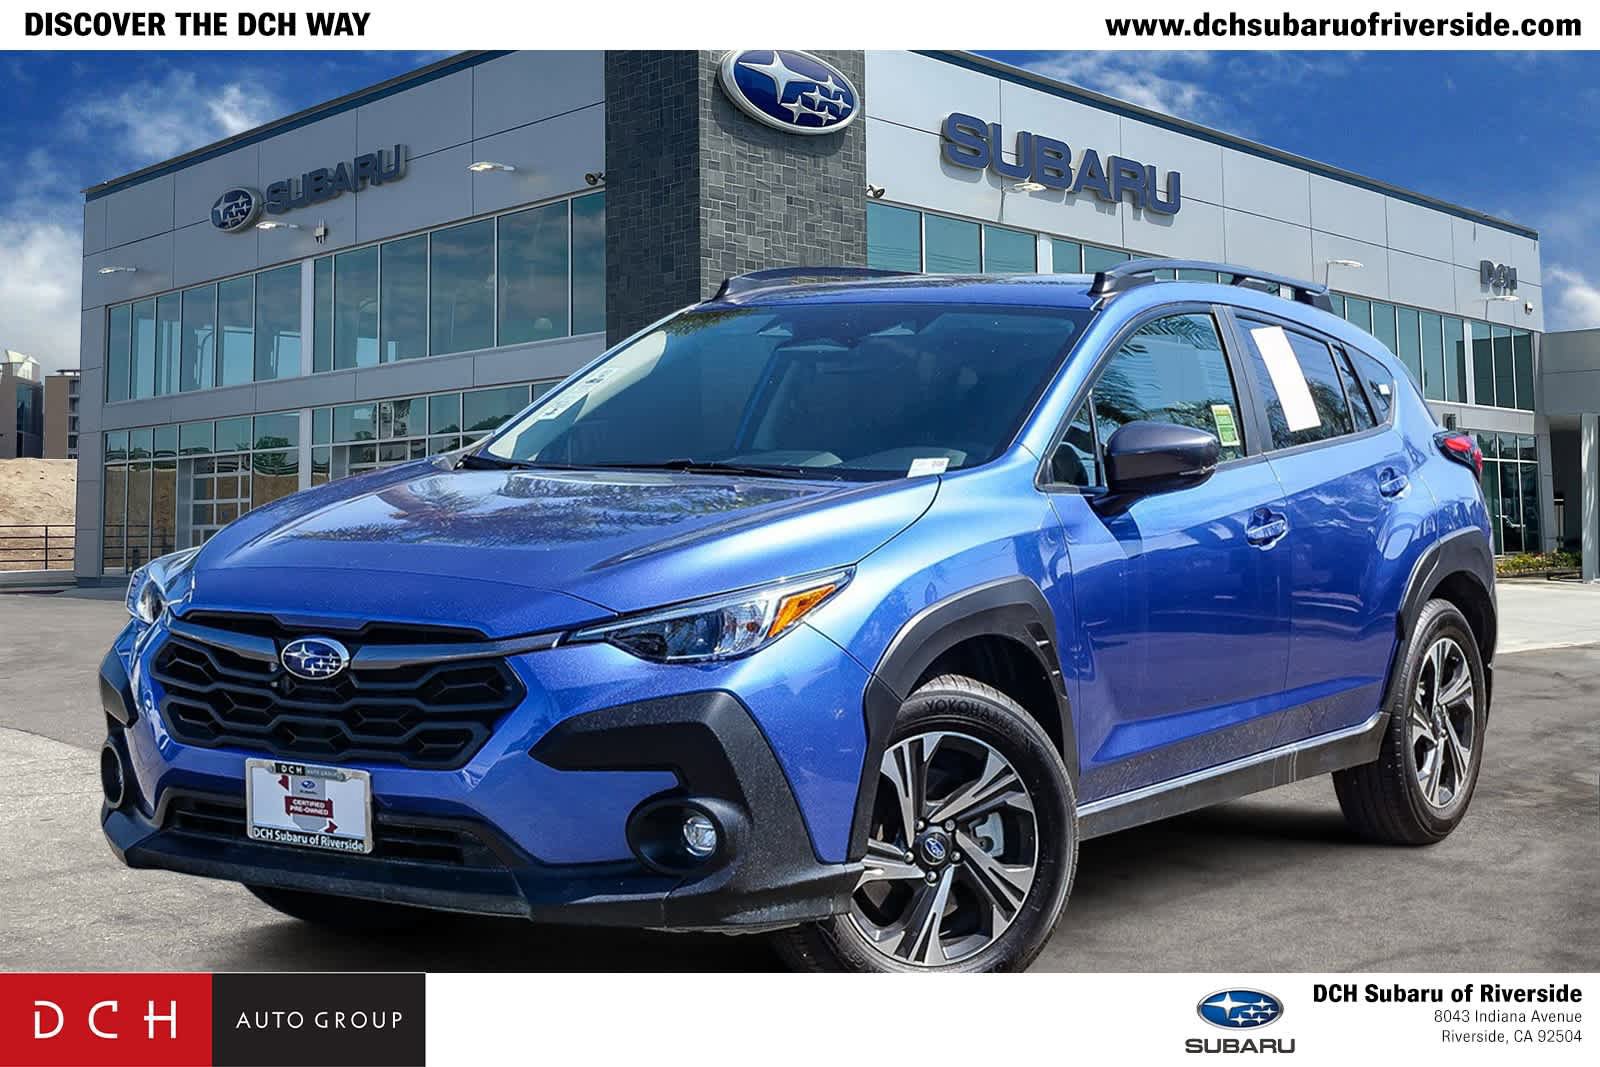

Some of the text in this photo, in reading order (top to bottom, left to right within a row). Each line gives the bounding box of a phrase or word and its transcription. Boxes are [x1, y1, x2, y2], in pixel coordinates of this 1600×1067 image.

[941, 112, 1181, 215] SUBARU
[266, 144, 407, 214] SUBARU
[290, 805, 328, 815] PRE-OWNED
[292, 799, 325, 808] CERTIFIED
[253, 827, 364, 851] DCH Subaru of Riverside
